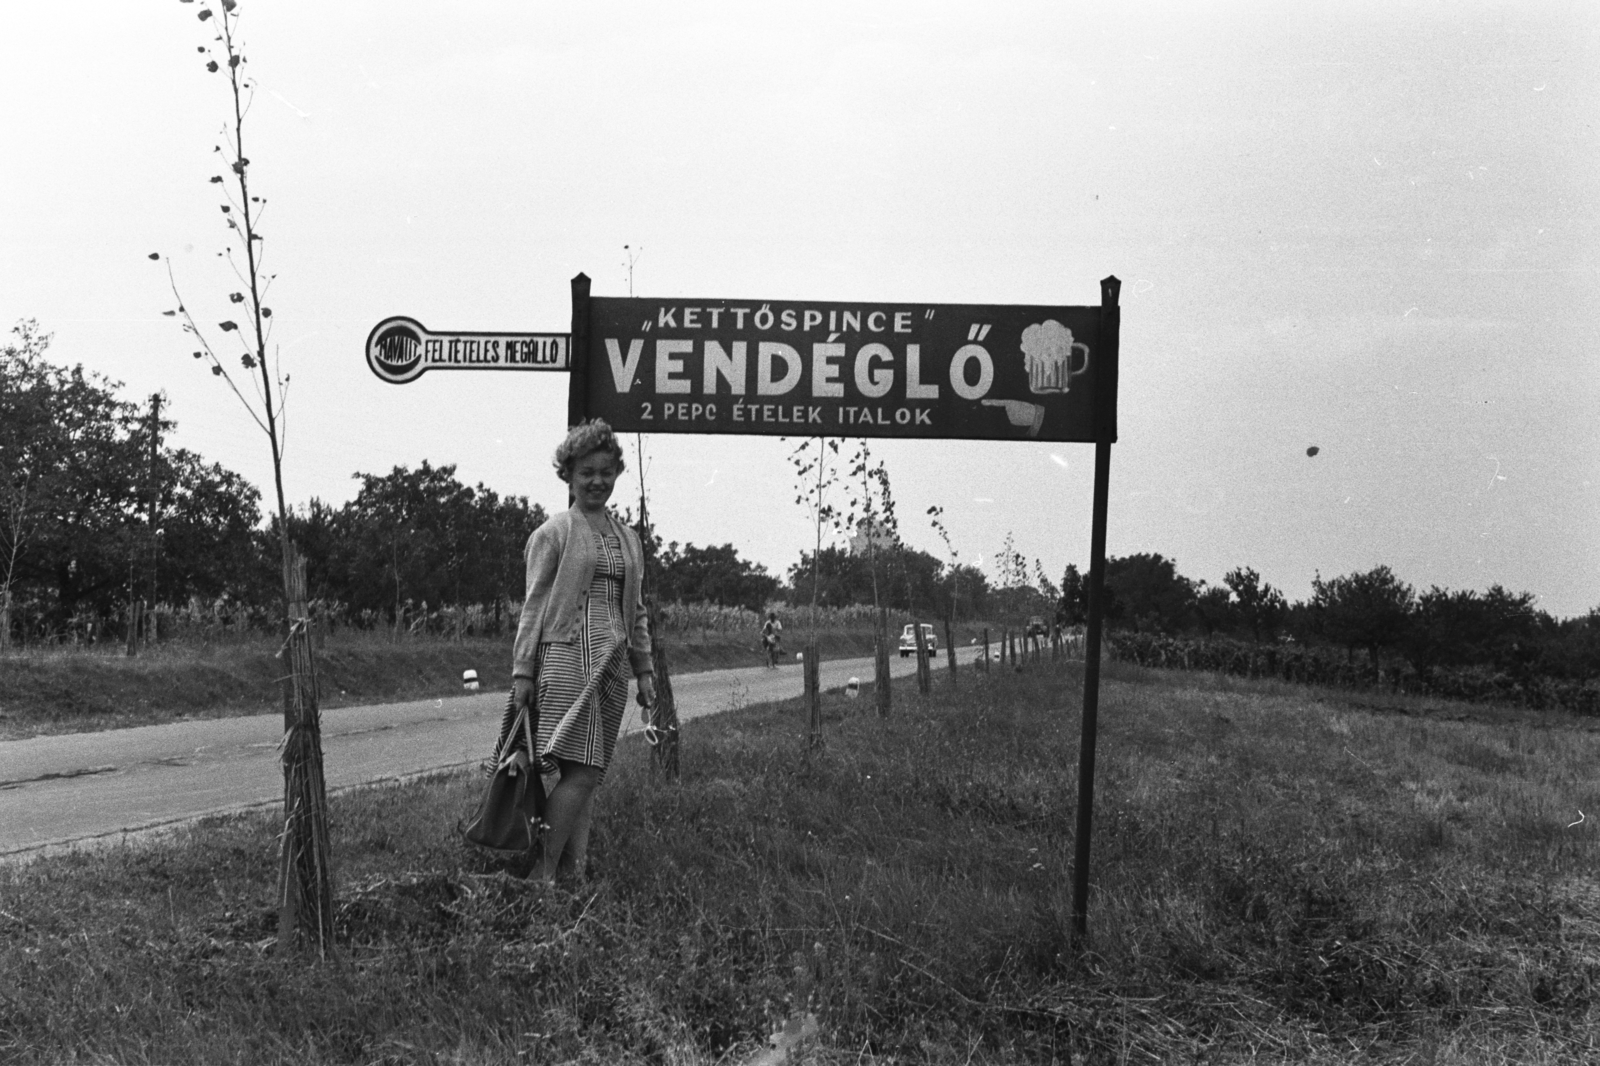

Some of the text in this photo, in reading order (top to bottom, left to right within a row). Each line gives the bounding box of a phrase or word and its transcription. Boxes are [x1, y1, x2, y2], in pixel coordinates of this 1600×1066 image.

[424, 338, 559, 365] FELTÉTELES MEGÁLLÓ
[604, 323, 995, 400] VENDÉGLŐ
[640, 402, 653, 420] 2
[732, 397, 823, 424] ÉTELEK
[838, 406, 933, 425] ITALOK
